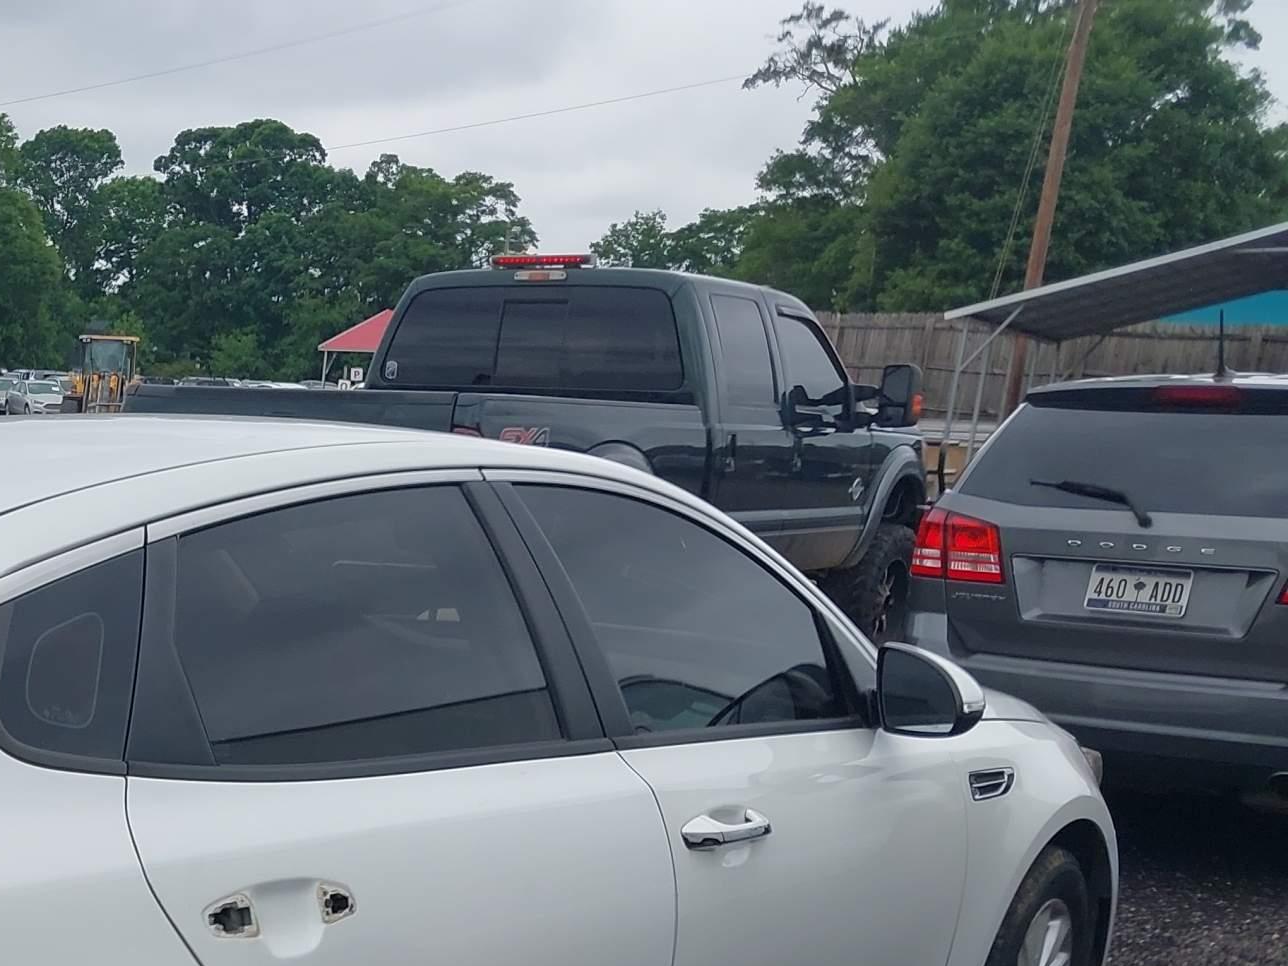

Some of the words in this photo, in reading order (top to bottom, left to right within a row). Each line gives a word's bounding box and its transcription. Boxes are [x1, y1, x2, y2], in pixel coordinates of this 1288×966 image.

[499, 427, 551, 447] FX4
[1067, 540, 1216, 555] DODGE
[1094, 576, 1128, 599] 460
[1149, 581, 1185, 604] ADD
